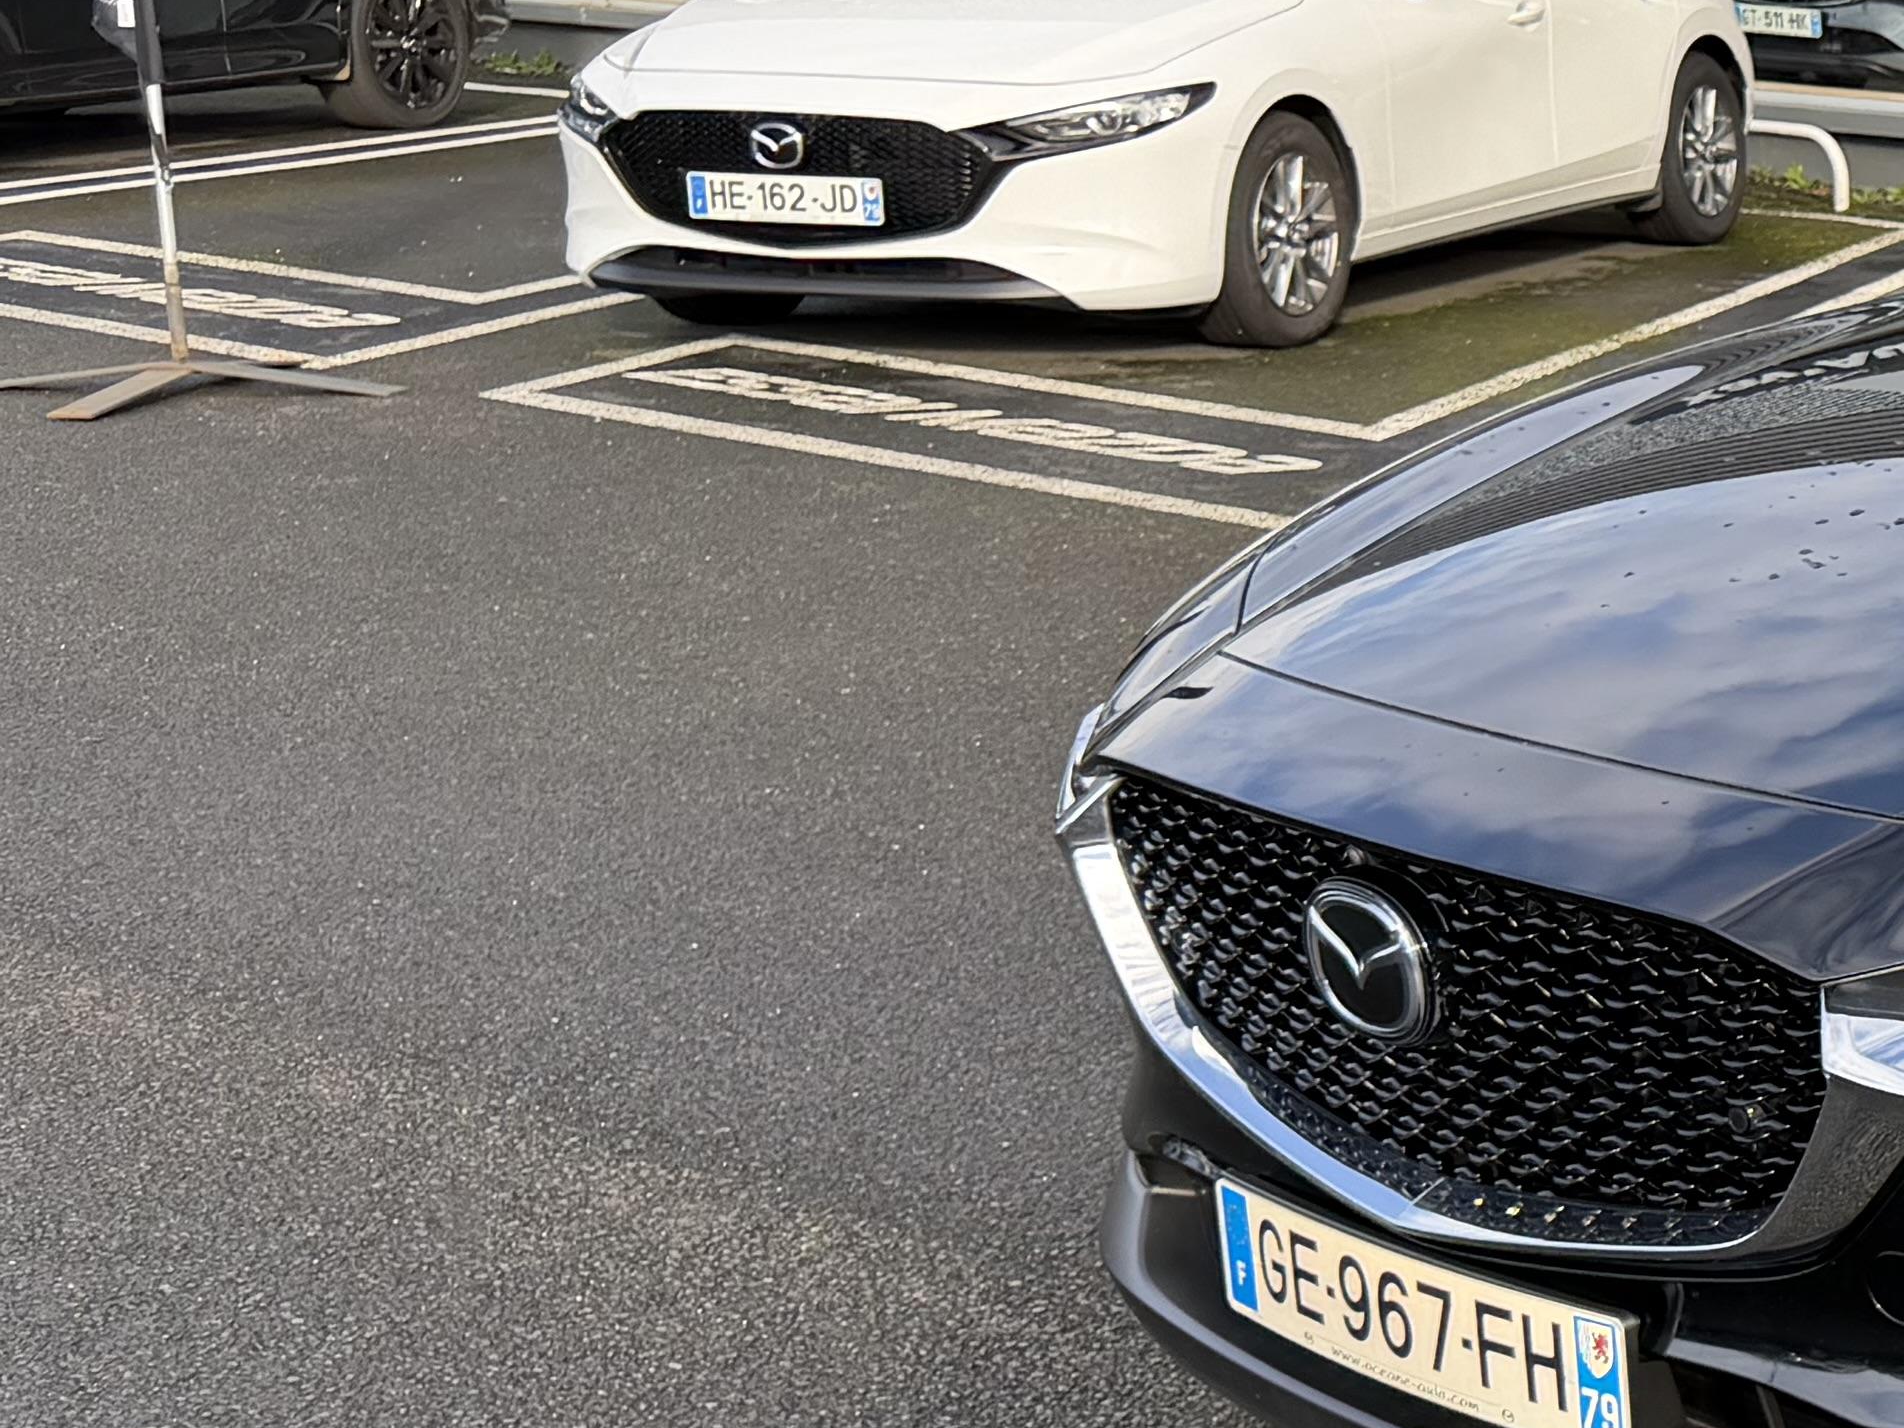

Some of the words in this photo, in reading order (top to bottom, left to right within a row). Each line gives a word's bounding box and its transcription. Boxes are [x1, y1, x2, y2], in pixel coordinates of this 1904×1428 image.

[709, 179, 858, 214] HE-162-JD
[1236, 1259, 1247, 1286] F
[1258, 1218, 1569, 1414] GE-967-FH
